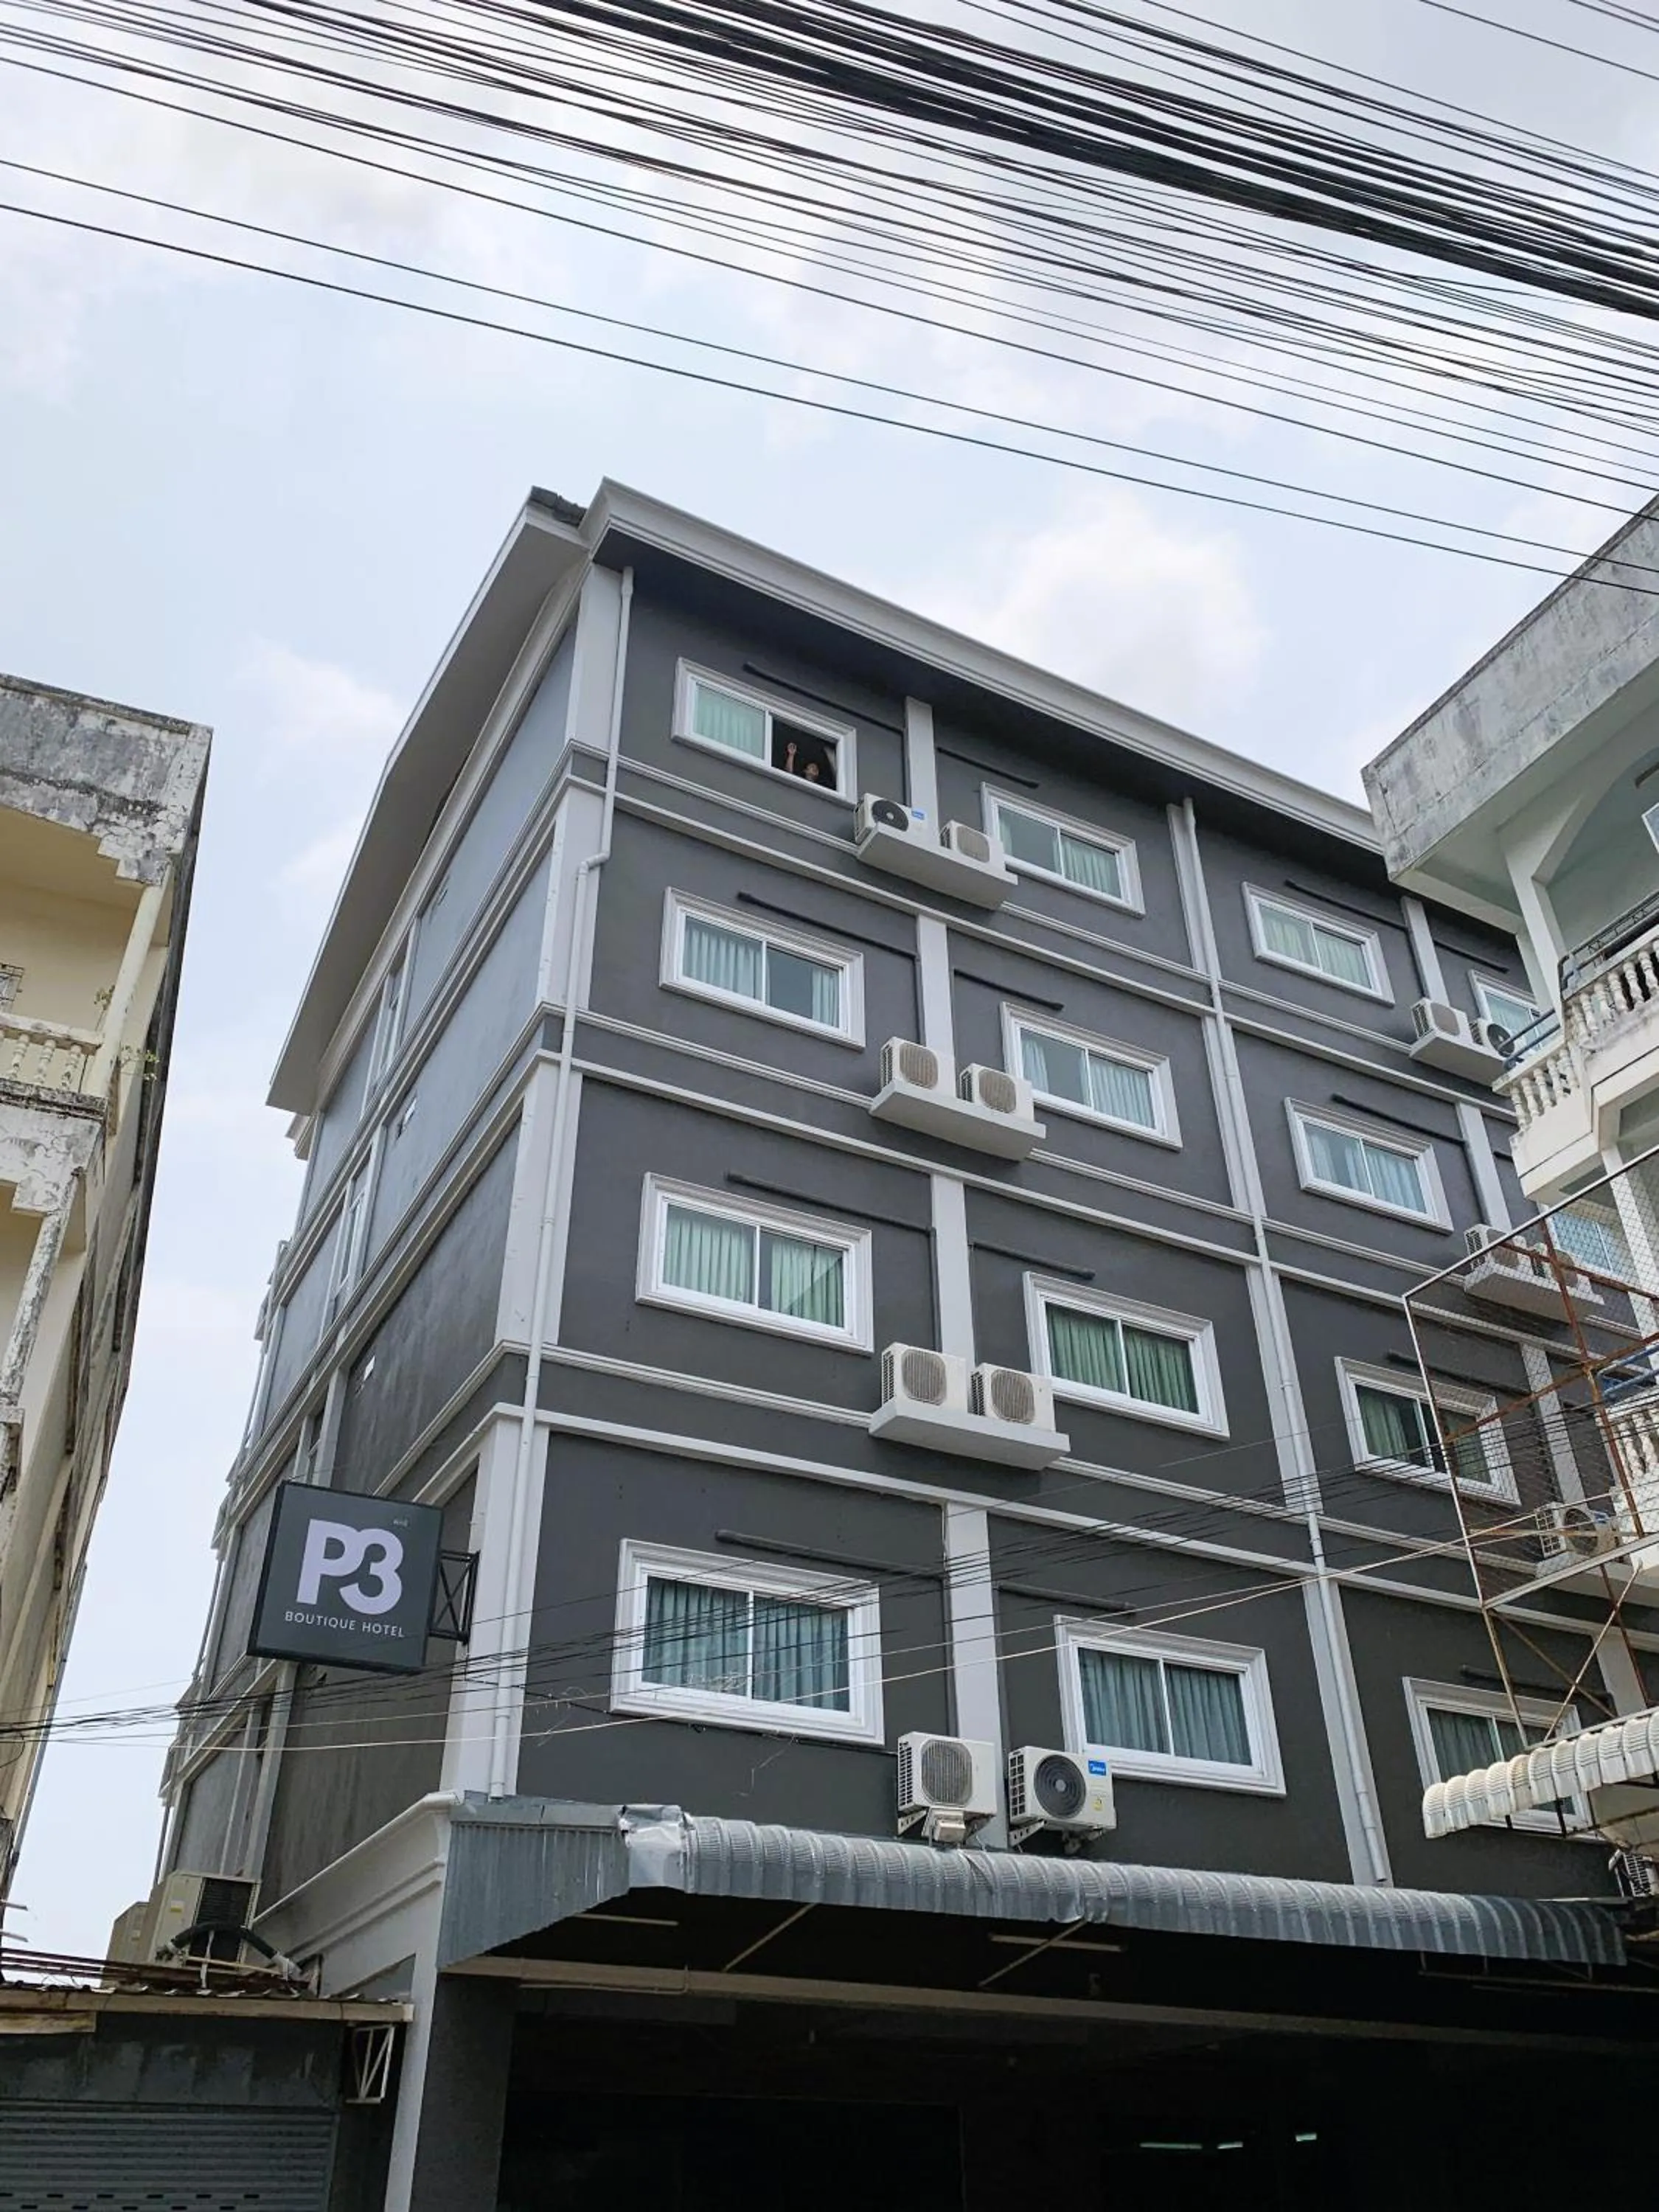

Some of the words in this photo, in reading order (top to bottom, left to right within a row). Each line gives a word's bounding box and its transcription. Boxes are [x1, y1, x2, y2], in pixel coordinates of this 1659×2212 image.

[296, 1518, 403, 1615] P3
[285, 1611, 355, 1630] BOUTIQUE
[361, 1621, 405, 1638] HOTEL
